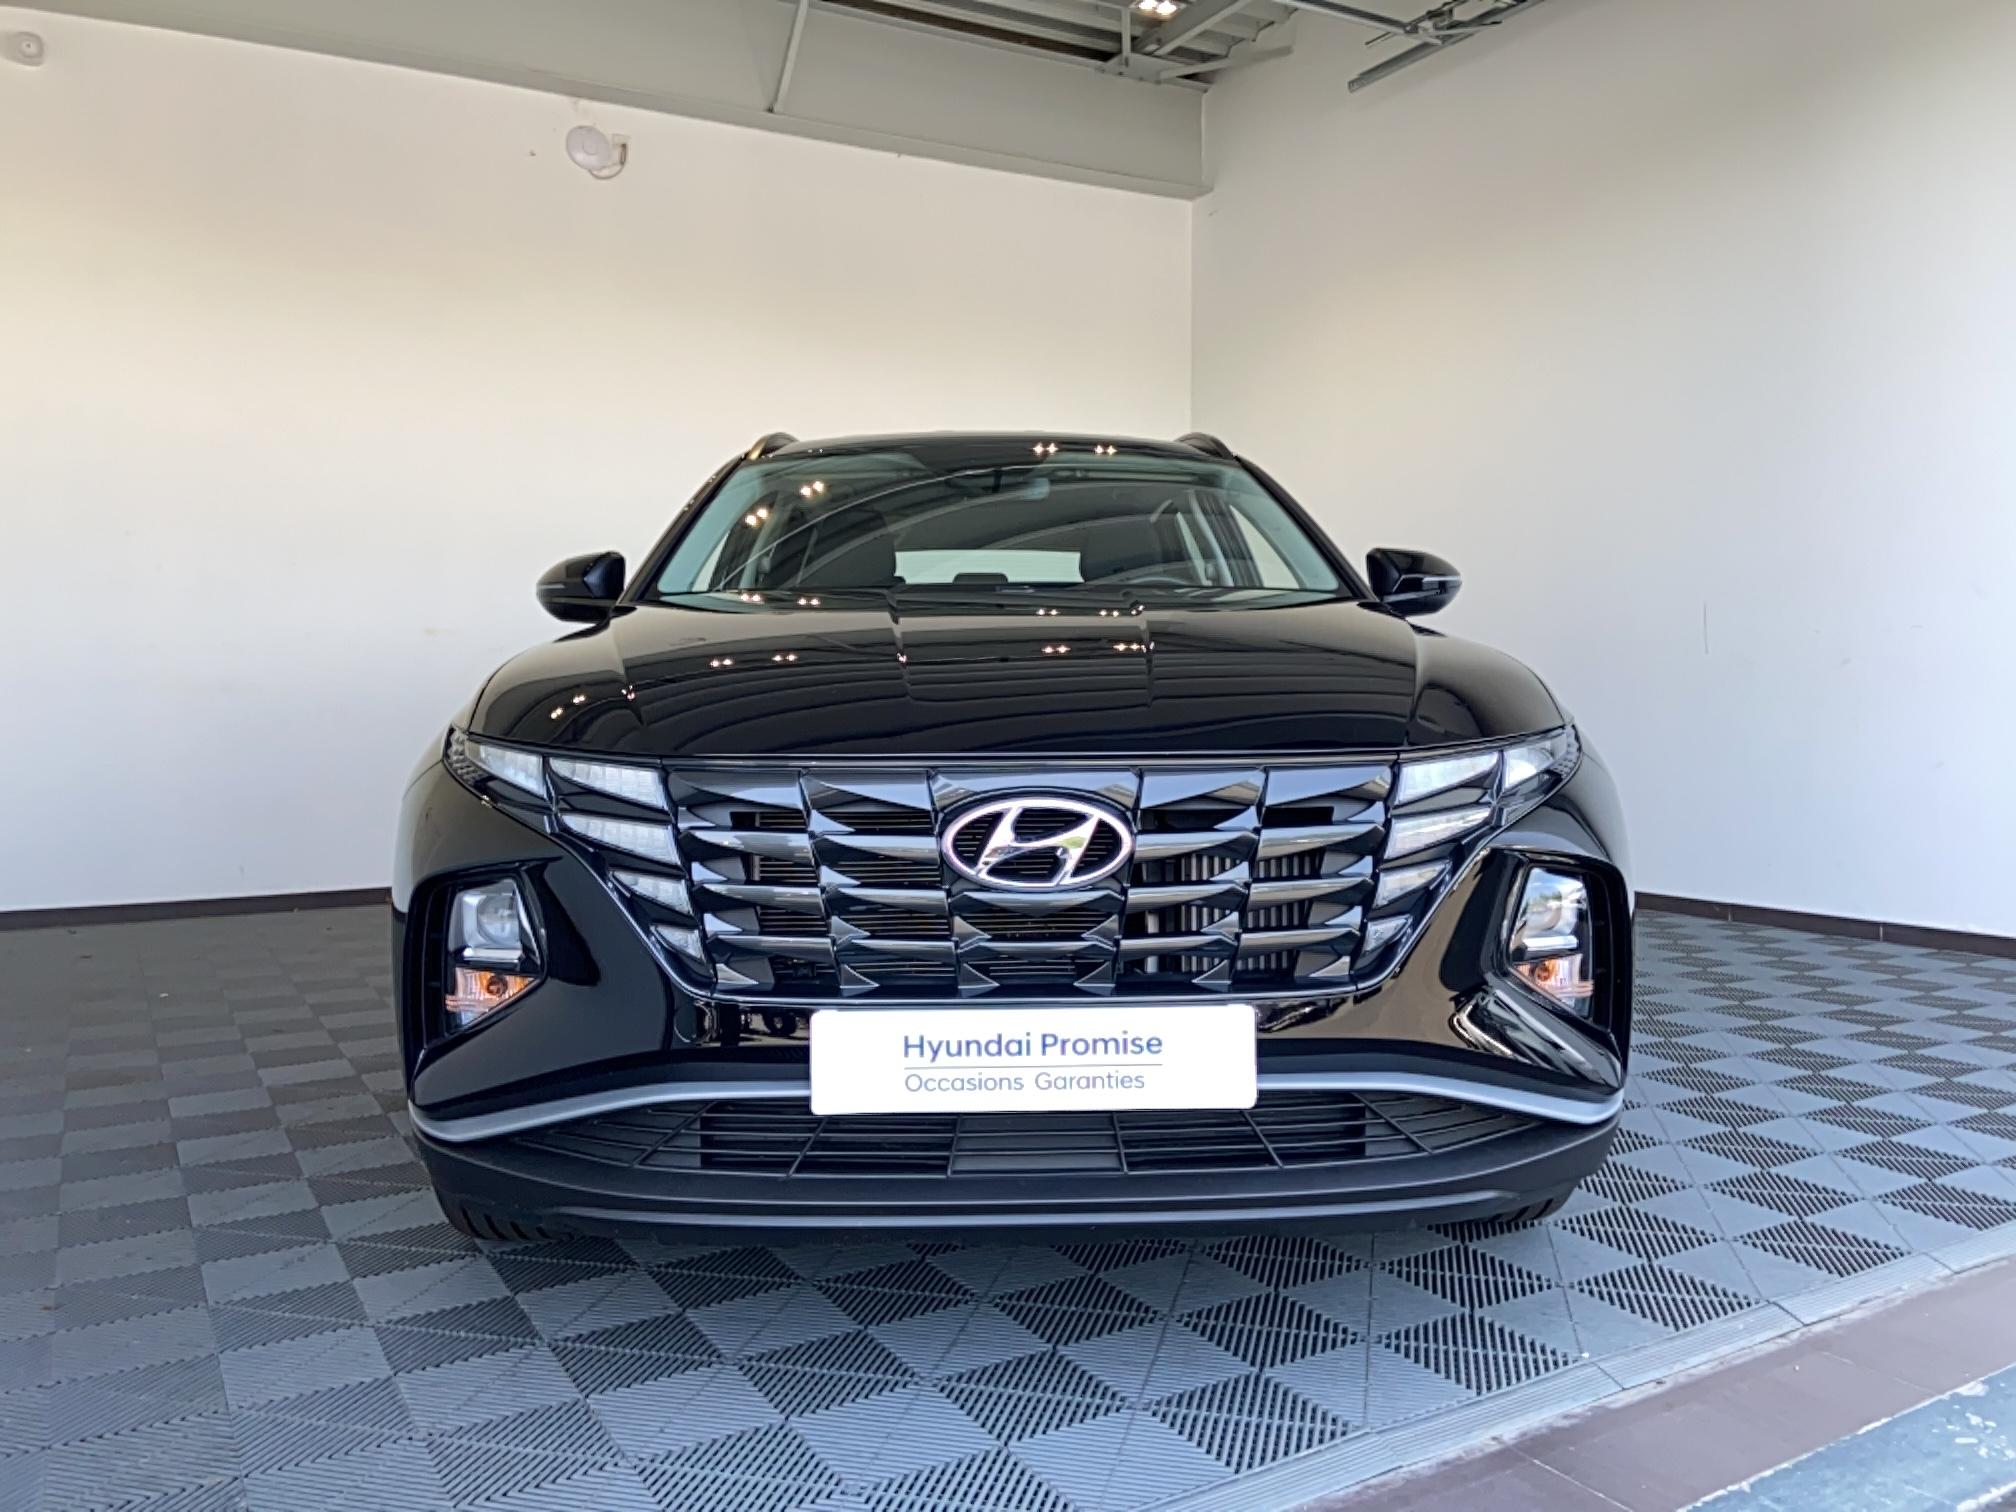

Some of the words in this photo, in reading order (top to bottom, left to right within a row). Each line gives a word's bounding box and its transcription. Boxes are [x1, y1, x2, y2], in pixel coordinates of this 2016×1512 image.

[903, 1032, 1031, 1062] Hyundai
[1040, 1030, 1163, 1056] Promise
[904, 1072, 1025, 1093] Occasions
[1034, 1070, 1145, 1091] Garanties
